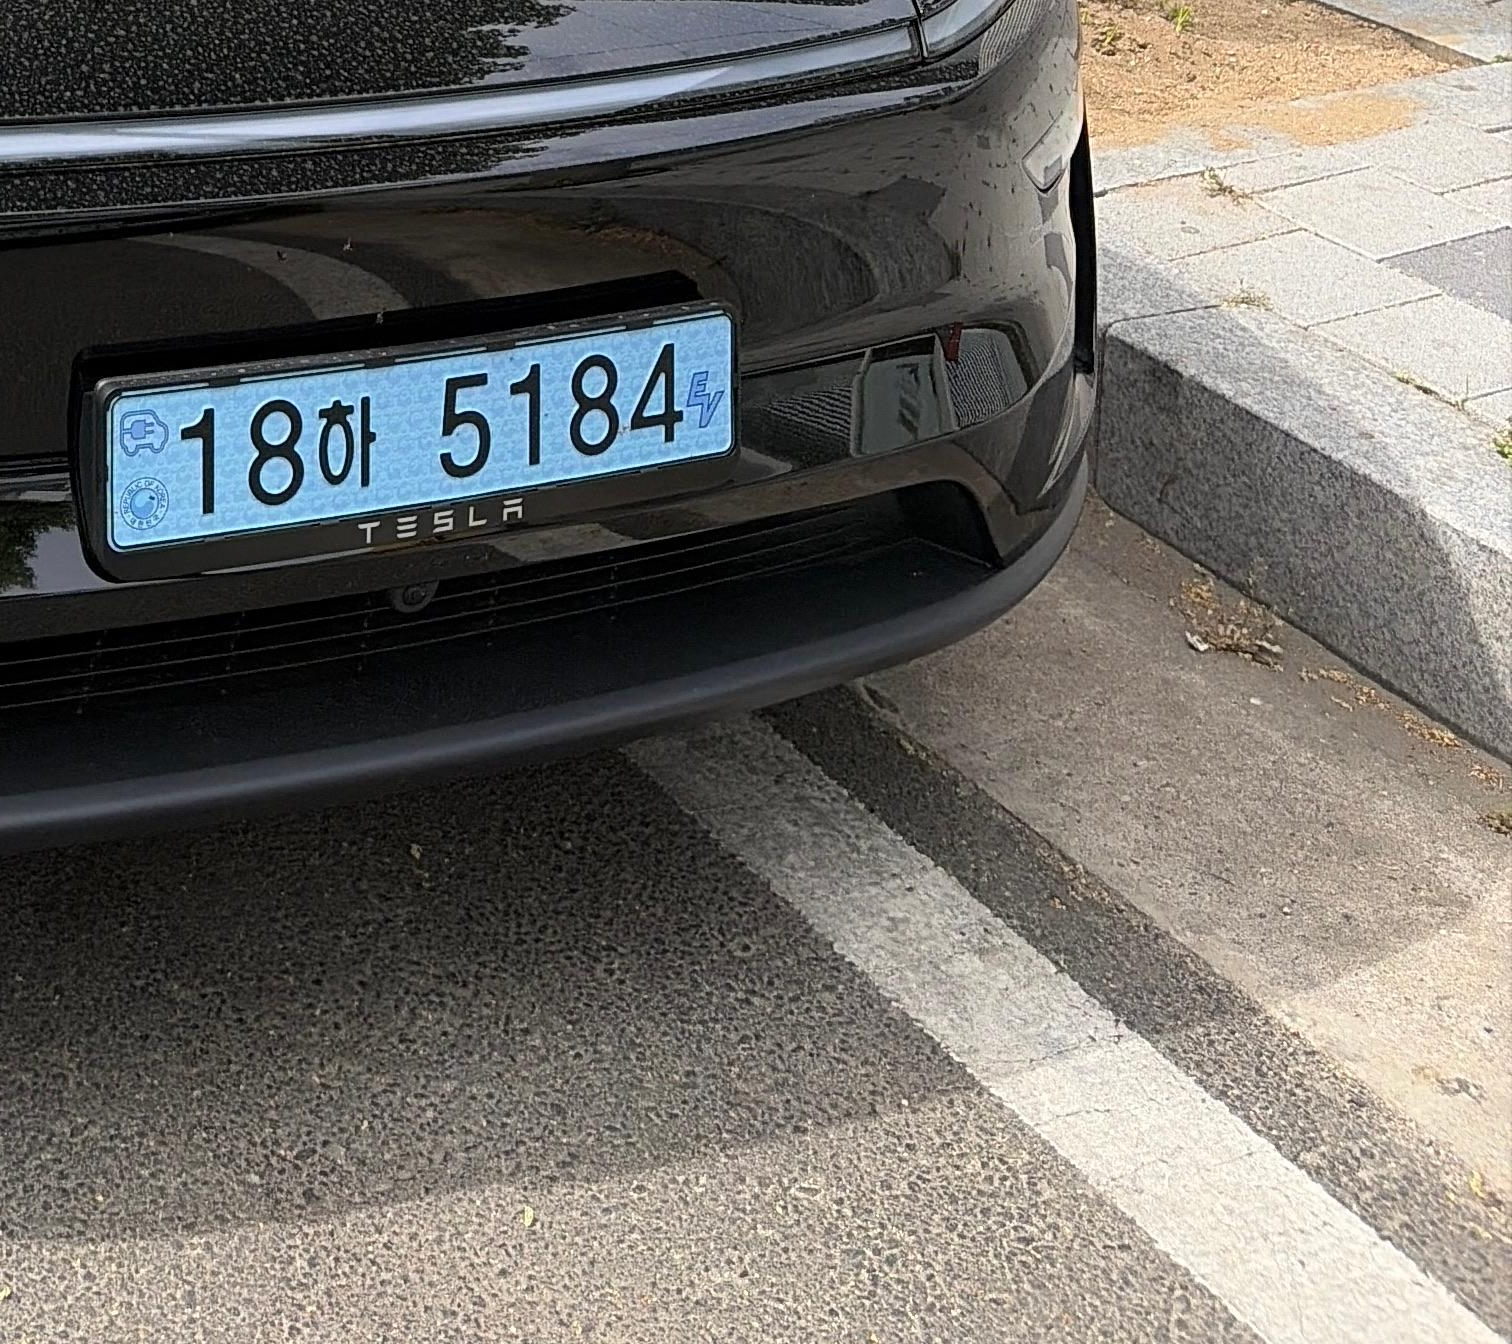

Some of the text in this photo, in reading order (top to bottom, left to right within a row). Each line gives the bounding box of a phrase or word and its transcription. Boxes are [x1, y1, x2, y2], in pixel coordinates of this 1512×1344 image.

[180, 343, 685, 515] 18하 5184
[686, 370, 724, 429] EV
[358, 498, 526, 543] TESLA
